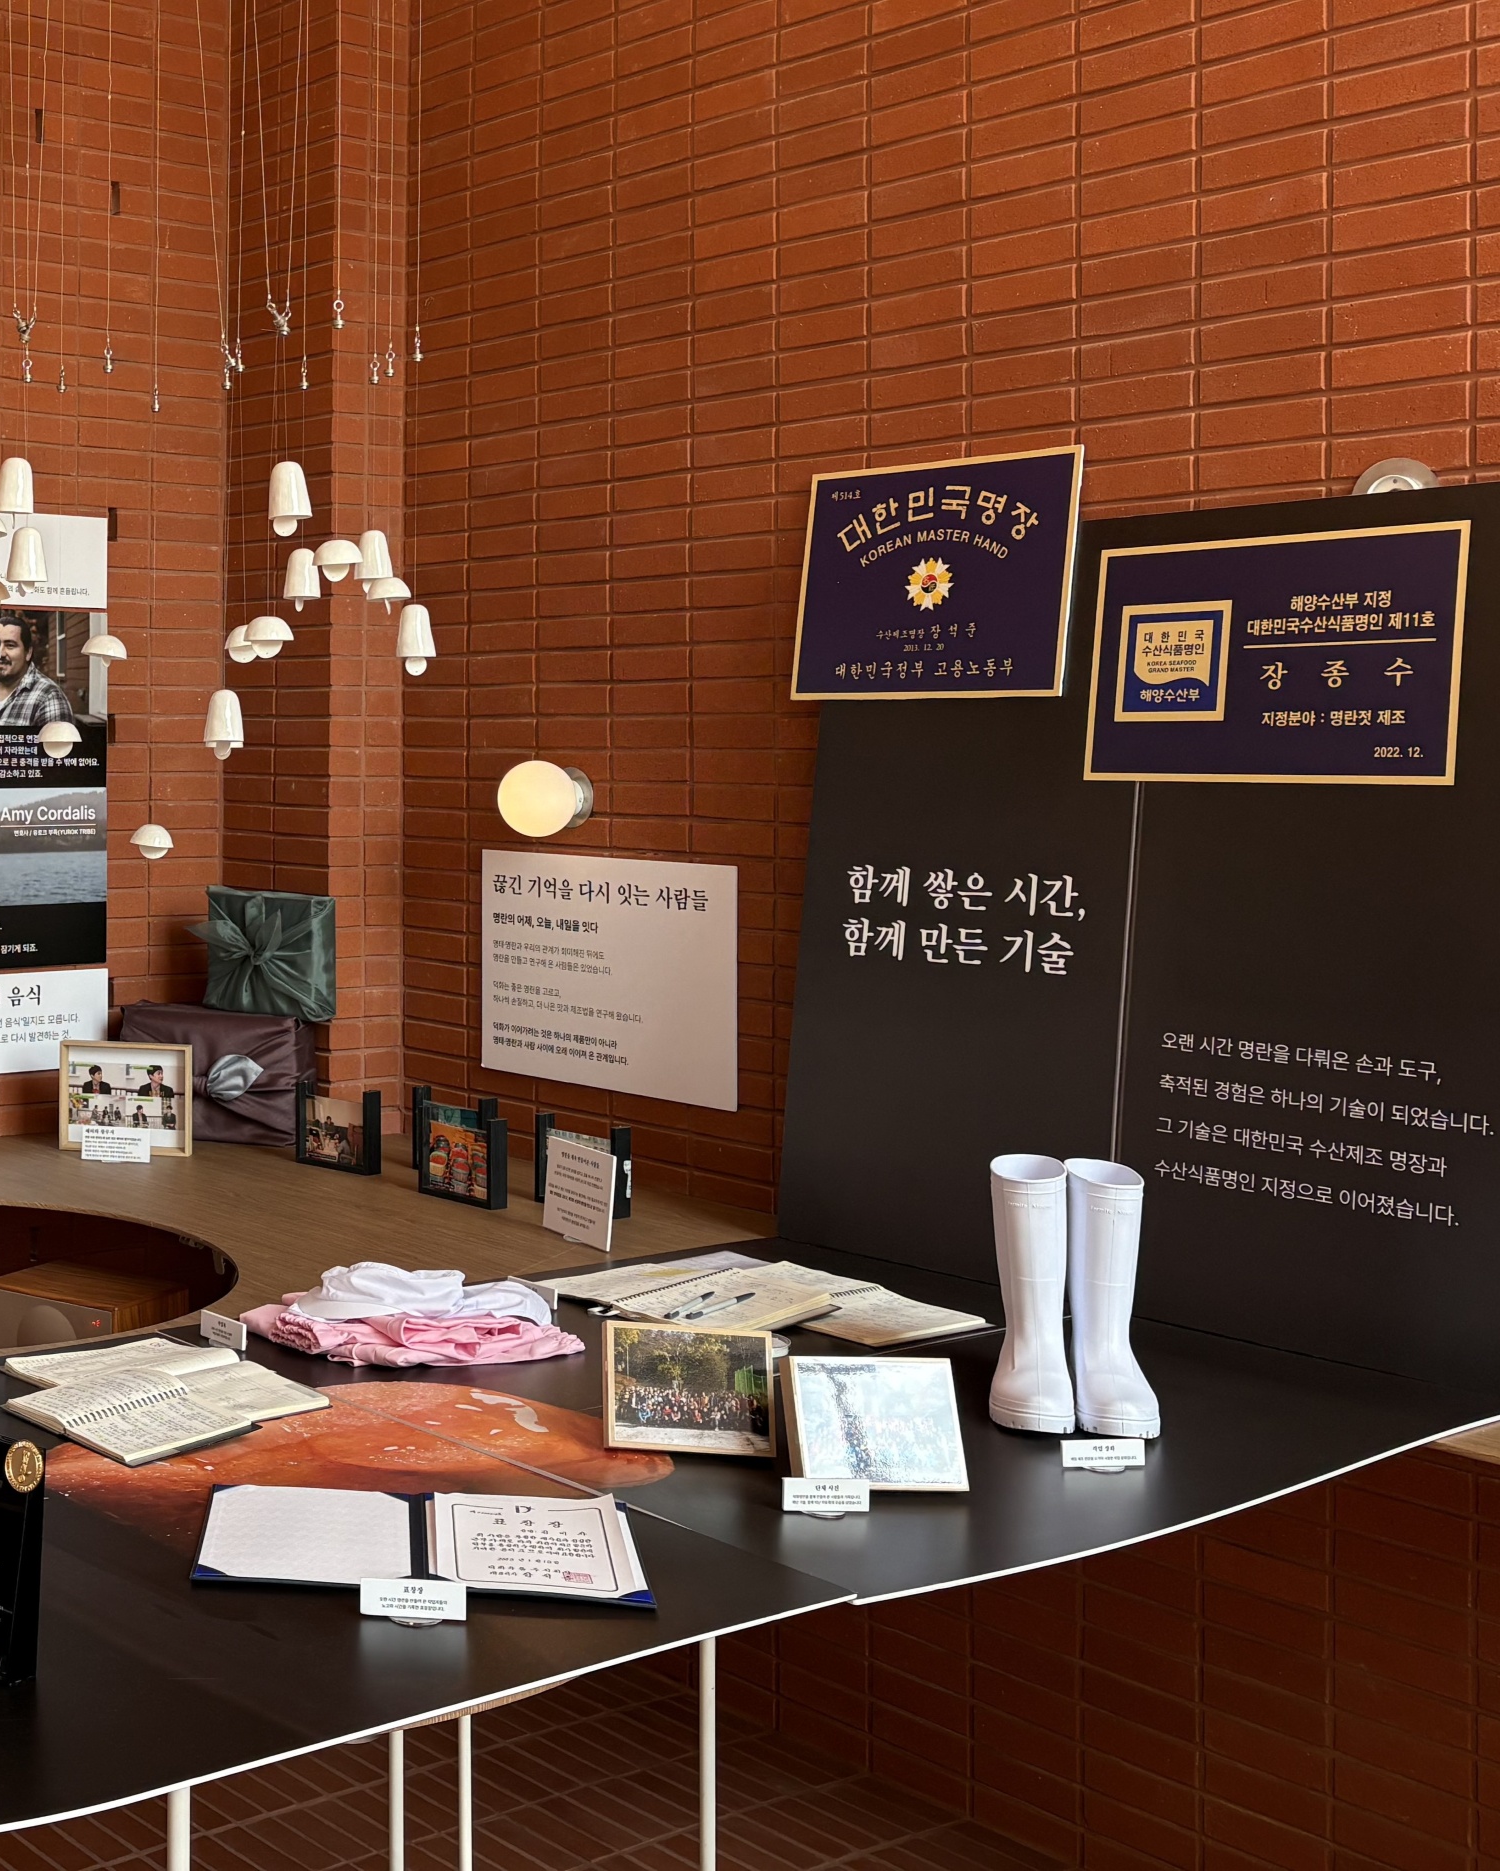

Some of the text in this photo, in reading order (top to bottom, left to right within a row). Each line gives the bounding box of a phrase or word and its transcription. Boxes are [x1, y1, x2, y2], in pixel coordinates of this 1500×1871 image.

[835, 486, 1038, 554] 대한민국명장
[859, 528, 1009, 568] KOREAN MASTER HAND
[1291, 590, 1391, 611] 해양수산부 지정
[1247, 611, 1435, 635] 대한민국수산식품명인 제11호
[1142, 641, 1204, 657] 수산식품명인
[836, 658, 1013, 679] 대한민국정부 고용노동부
[1147, 665, 1195, 674] GRAND MASTER
[1169, 659, 1197, 667] SEAFOOD
[1140, 688, 1199, 703] 해양수산부
[1262, 710, 1405, 726] 지정분야 명란젓 제조
[1374, 747, 1423, 757] 2022. 12.
[0, 805, 96, 824] Amy Cordalis
[492, 874, 709, 912] 끊긴 기억을 다시 잇는 사람들
[847, 864, 1085, 922] 함께 쌓은 시간,
[492, 912, 599, 934] 명란의 어제, 오늘, 내일을 잇다
[842, 917, 1074, 975] 함께 만든 기술
[7, 984, 41, 1007] 음식
[1161, 1032, 1441, 1085] 오랜 시간 명란을 다뤄온 손과 도구,
[1159, 1073, 1494, 1136] 축적된 경험은 하나의 기술이 되었습니다.
[1156, 1117, 1447, 1178] 그 기술은 대한민국 수산제조 명장과
[1153, 1159, 1459, 1227] 수산식품명인 지정으로 이어졌습니다.
